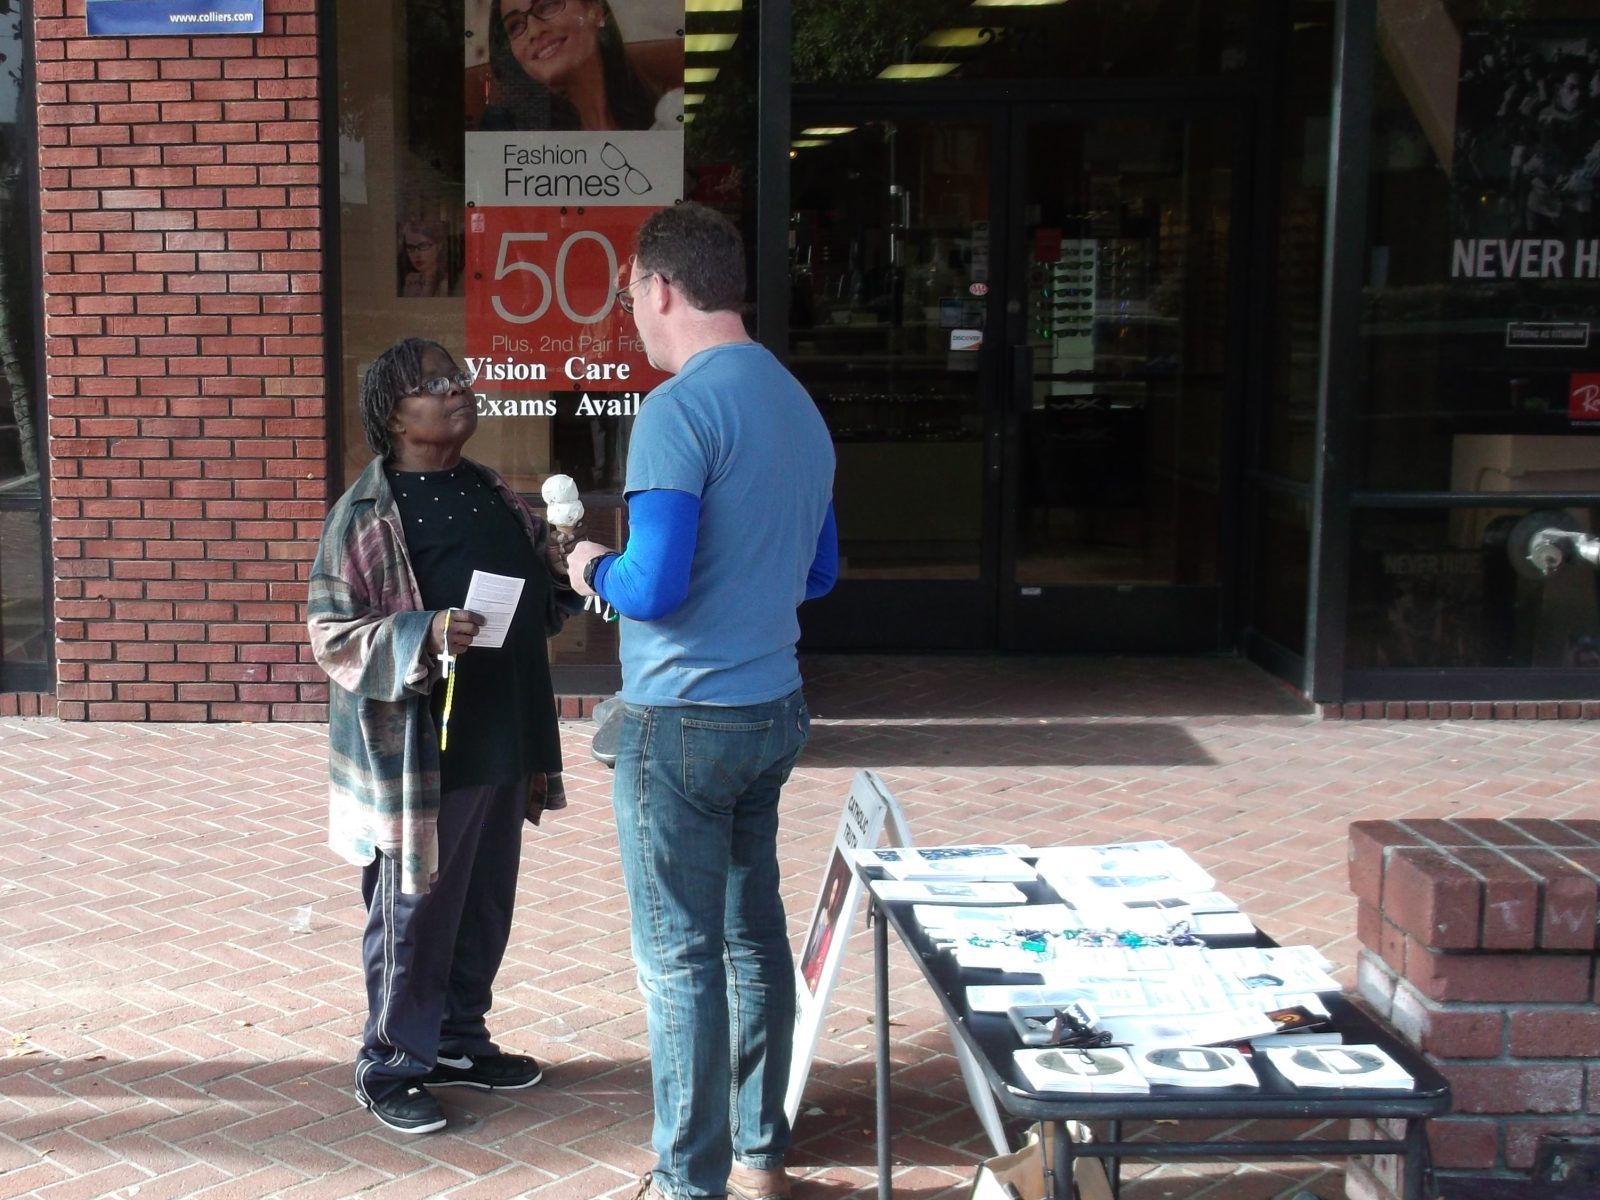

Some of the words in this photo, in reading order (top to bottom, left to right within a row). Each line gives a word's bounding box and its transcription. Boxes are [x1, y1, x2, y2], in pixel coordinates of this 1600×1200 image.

[169, 12, 254, 22] www.colliers.com
[504, 144, 587, 165] Fashion
[504, 168, 620, 197] Frames
[1451, 239, 1566, 278] NEVER
[1573, 239, 1600, 278] H
[492, 335, 533, 353] Plus,
[540, 335, 574, 352] 2nd
[580, 335, 613, 352] Pair
[618, 335, 646, 352] Fre
[464, 357, 547, 380] Vision
[564, 356, 630, 380] Care
[474, 393, 557, 417] Exams
[575, 392, 640, 417] Avail
[848, 795, 869, 835] CATHOLIC
